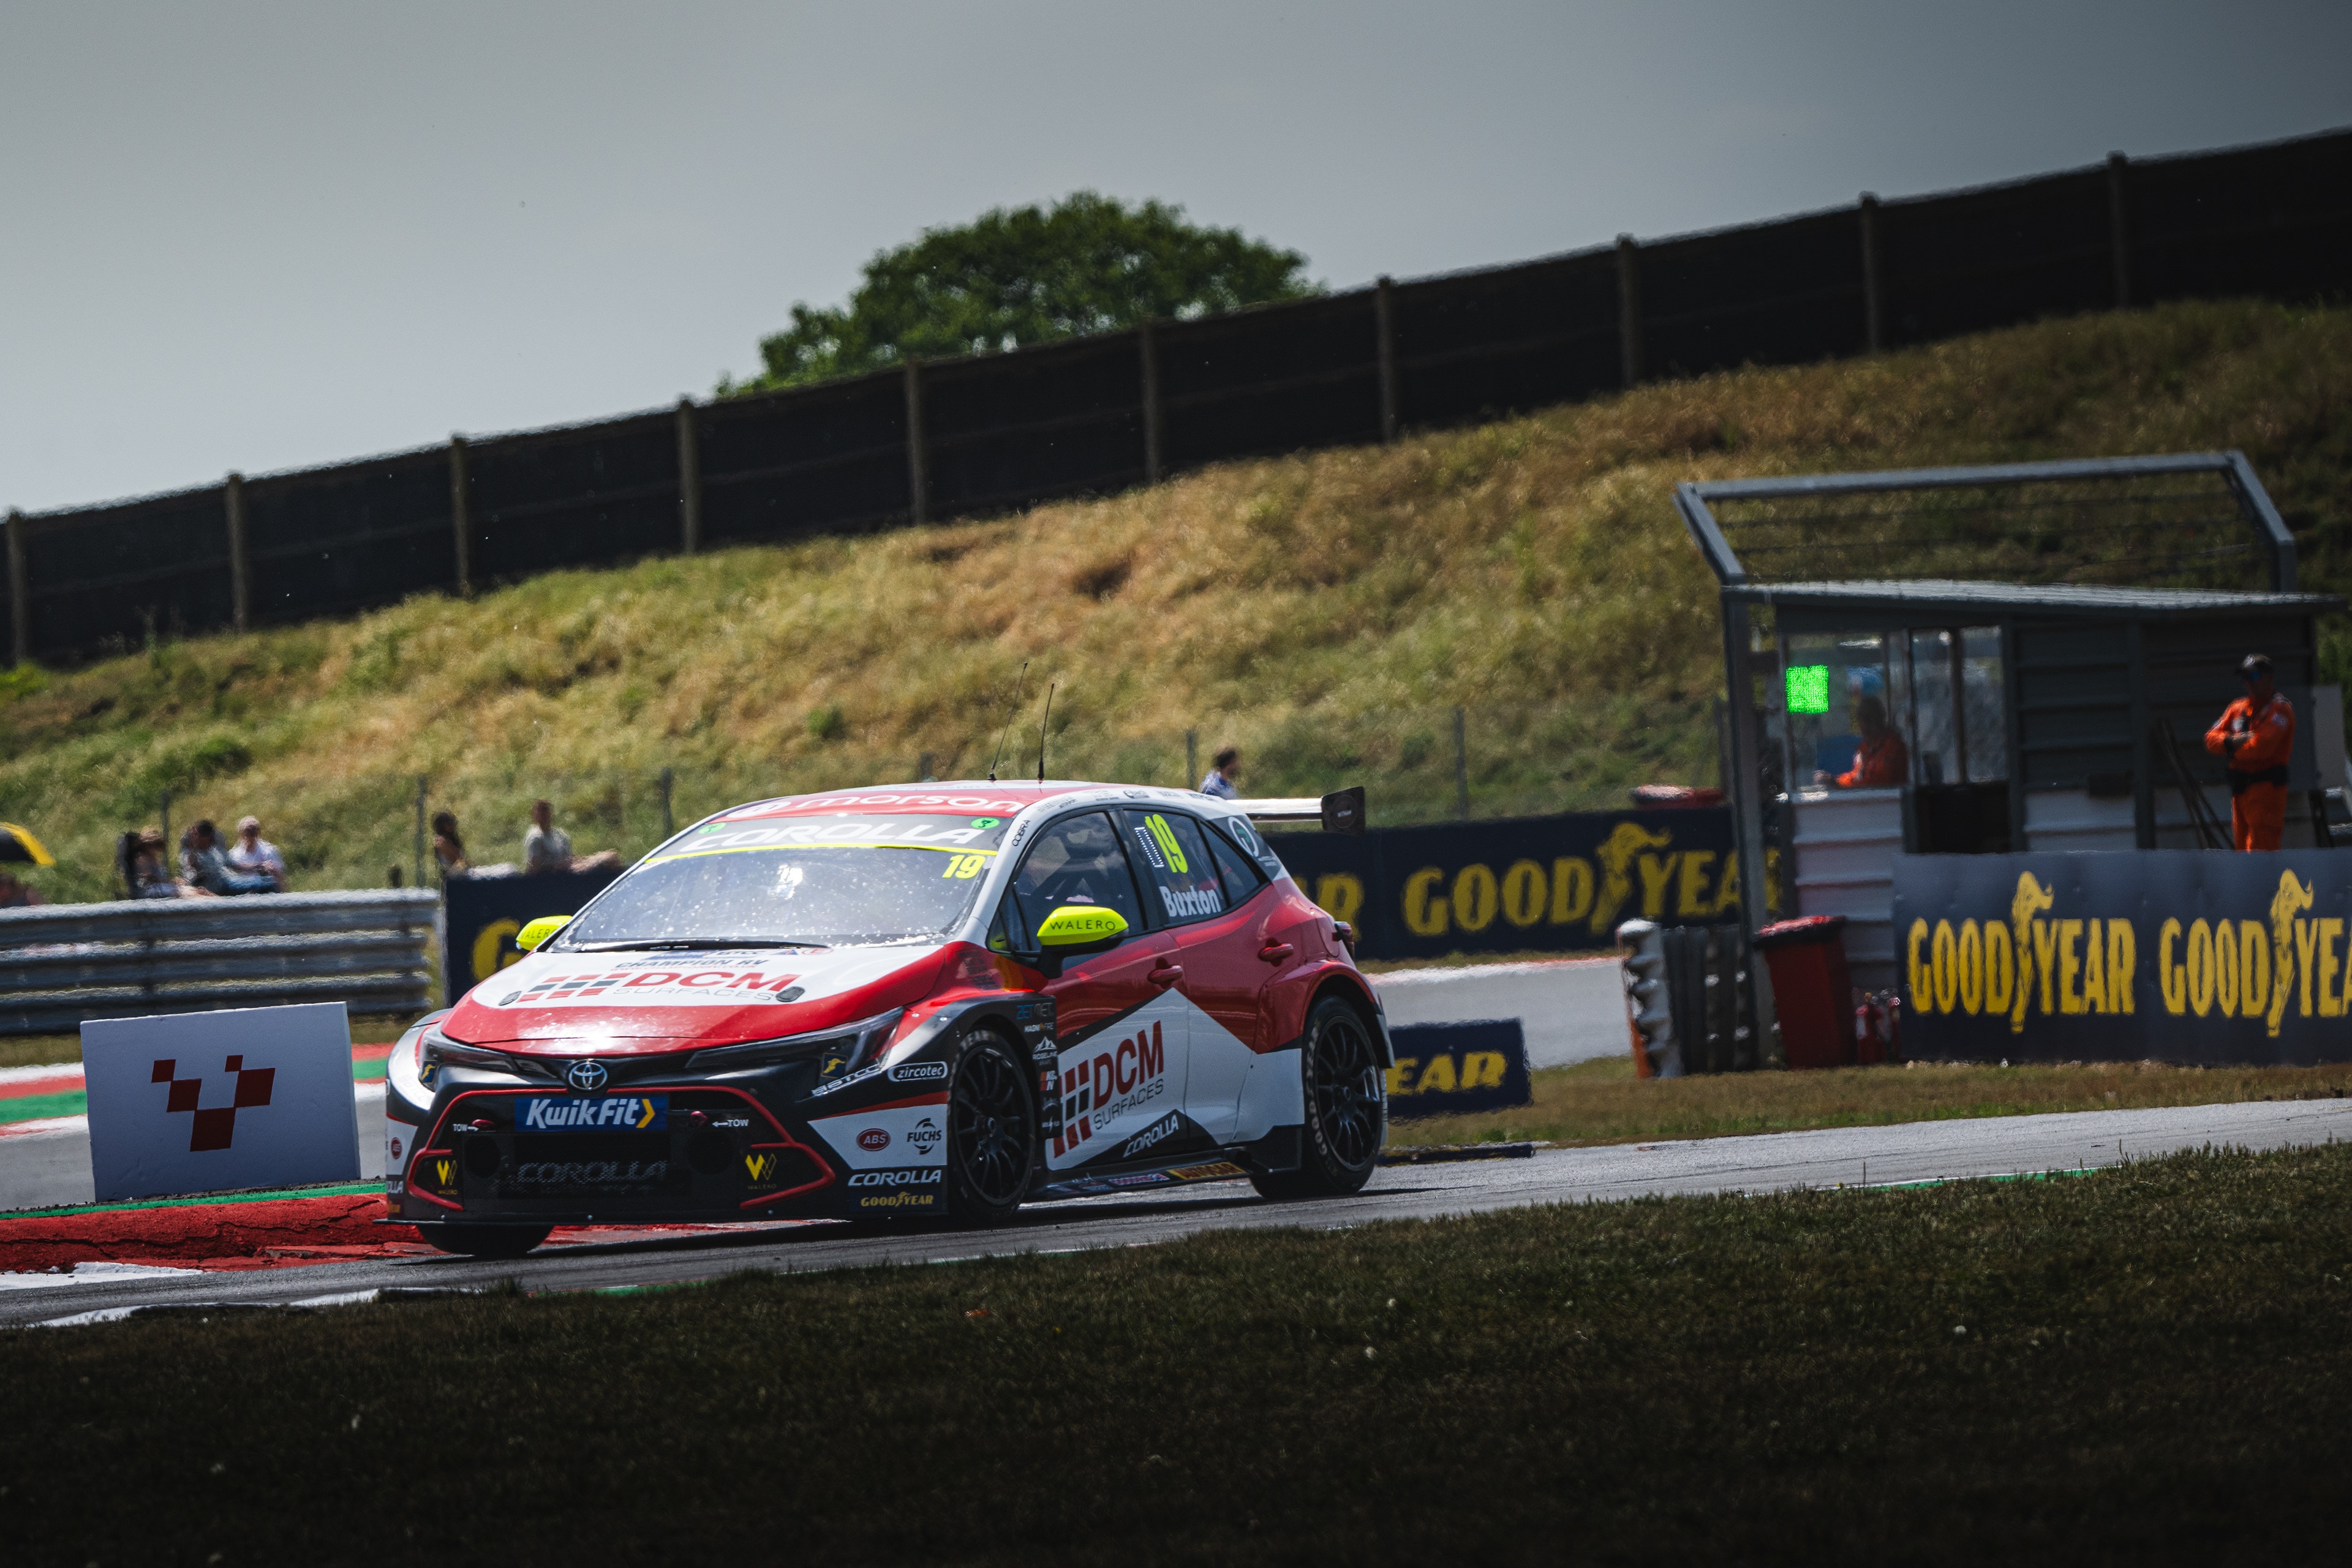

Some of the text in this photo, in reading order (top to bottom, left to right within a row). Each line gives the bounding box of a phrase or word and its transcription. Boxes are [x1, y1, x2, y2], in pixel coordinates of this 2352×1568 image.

[796, 794, 1026, 813] morson
[679, 823, 986, 853] COROLLA
[1011, 819, 1031, 846] COBRA
[1144, 814, 1188, 873] 19
[941, 854, 986, 880] 19
[1159, 886, 1222, 917] Buxton
[1049, 919, 1116, 931] WALERO
[615, 960, 730, 968] CHAMPION
[1906, 917, 2138, 1017] GOODYEAR
[622, 971, 803, 993] DCM
[612, 987, 777, 1001] SURFACES
[897, 1065, 943, 1079] zircotec
[1093, 1020, 1164, 1111] DCM
[1093, 1079, 1164, 1130] SURFACES
[863, 1134, 886, 1144] ABS
[907, 1130, 941, 1142] FUCHS
[1123, 1114, 1179, 1158] COROLLA
[518, 1161, 668, 1183] COROLLA
[848, 1169, 941, 1186] COROLLA
[861, 1194, 934, 1207] GOODYEAR
